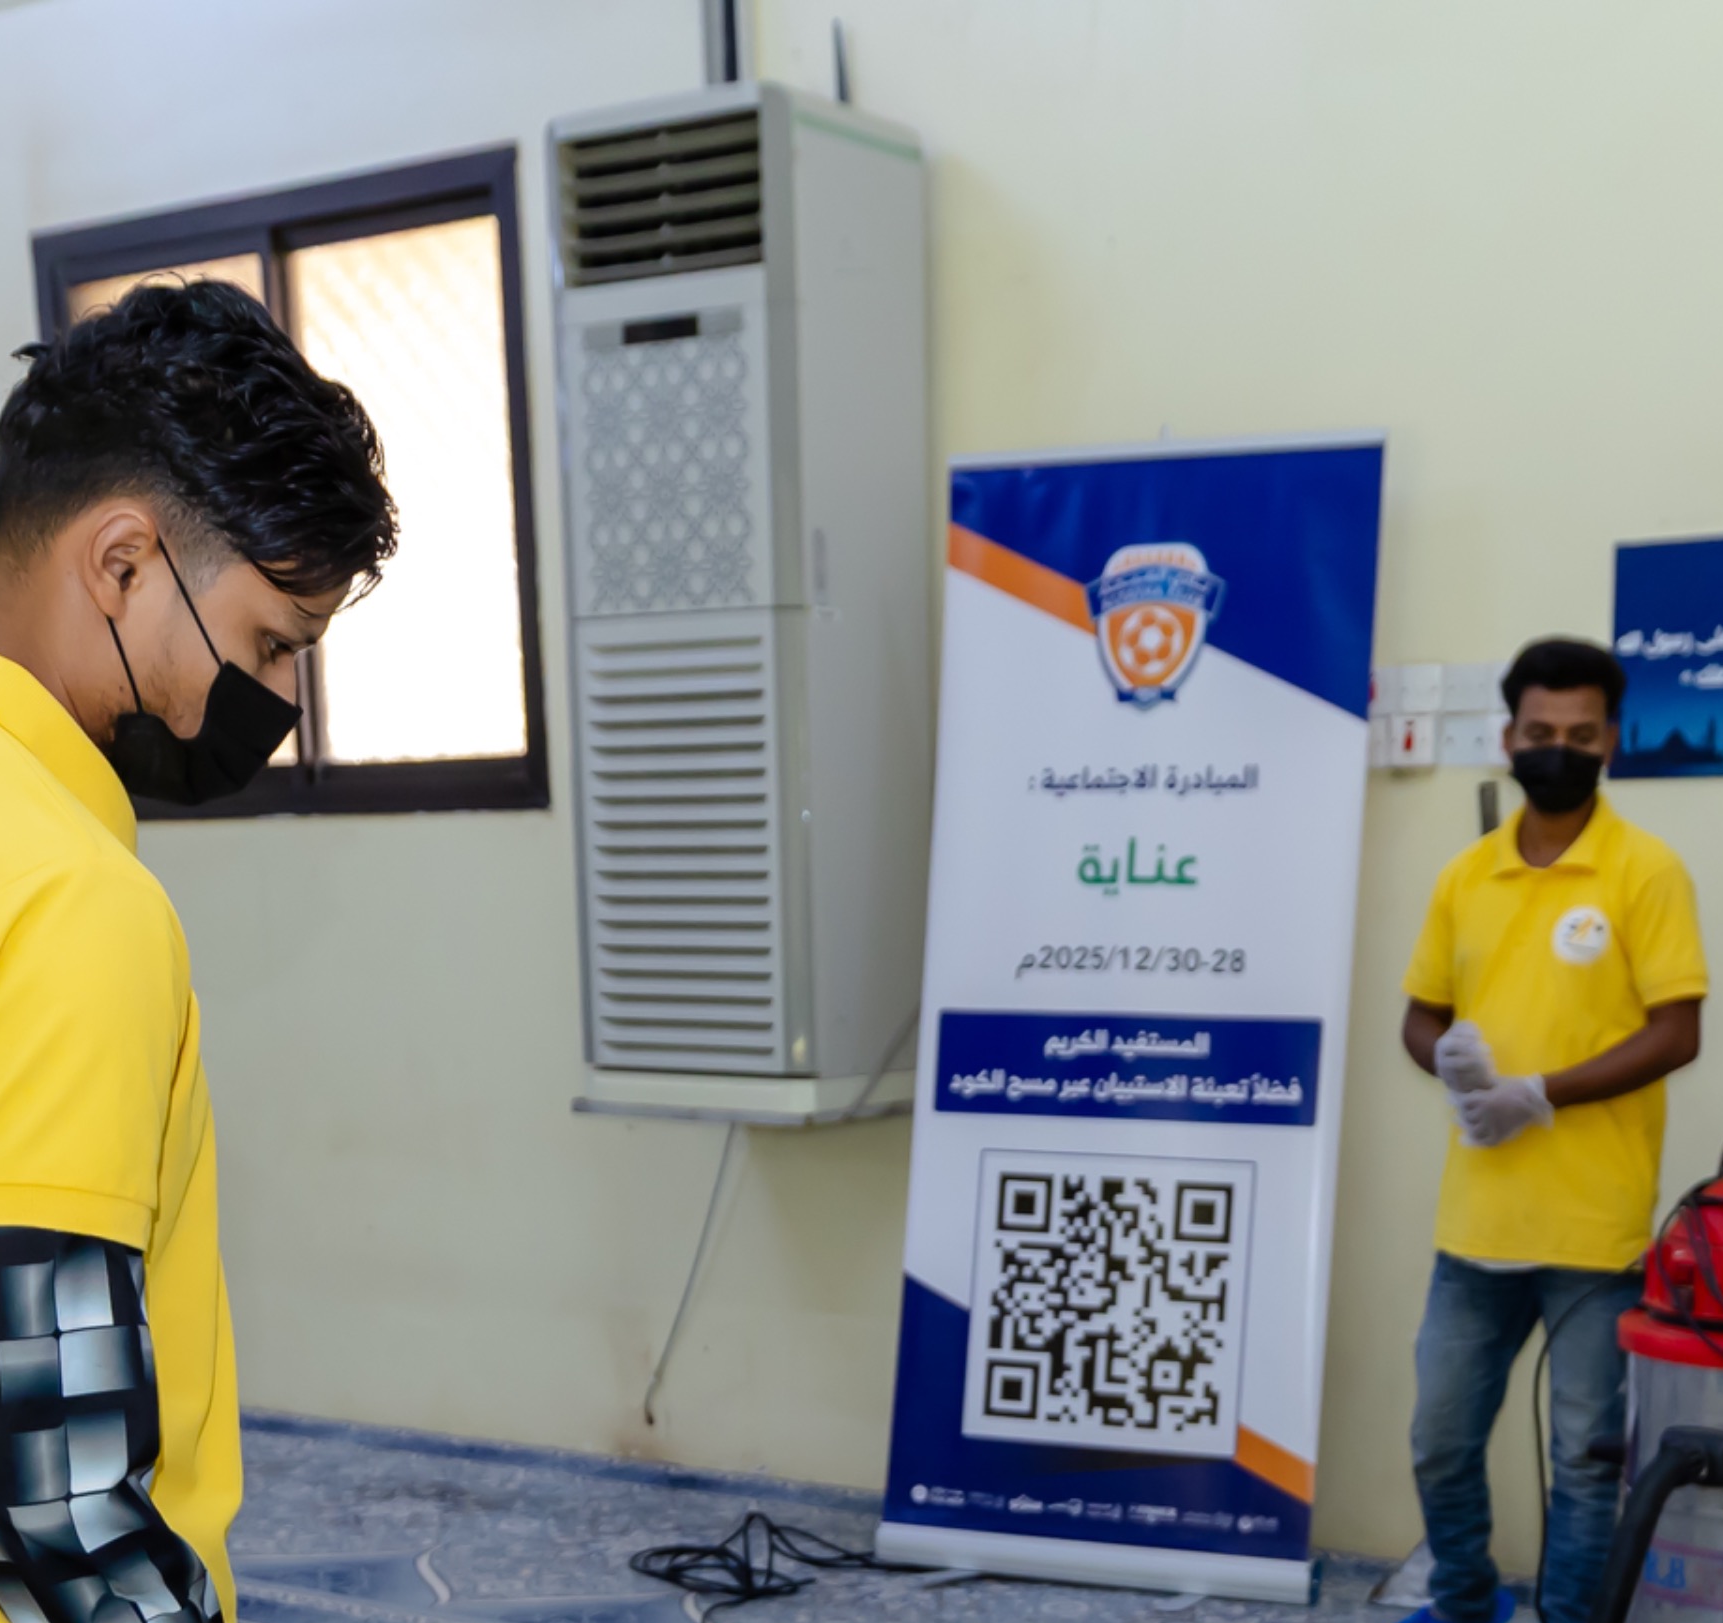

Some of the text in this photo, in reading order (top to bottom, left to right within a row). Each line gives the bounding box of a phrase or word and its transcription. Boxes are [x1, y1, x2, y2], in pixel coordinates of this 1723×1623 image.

[1041, 764, 1158, 798] الاجتماعية
[1164, 763, 1260, 797] المبادرة
[1077, 836, 1199, 896] عناية
[1043, 1028, 1211, 1062] المستفيد الكريم
[948, 1068, 1006, 1099] الكود
[1006, 1074, 1057, 1102] مسح
[1057, 1077, 1092, 1103] عبر
[1093, 1072, 1188, 1105] الاستبيان
[1190, 1075, 1249, 1108] تعبئة
